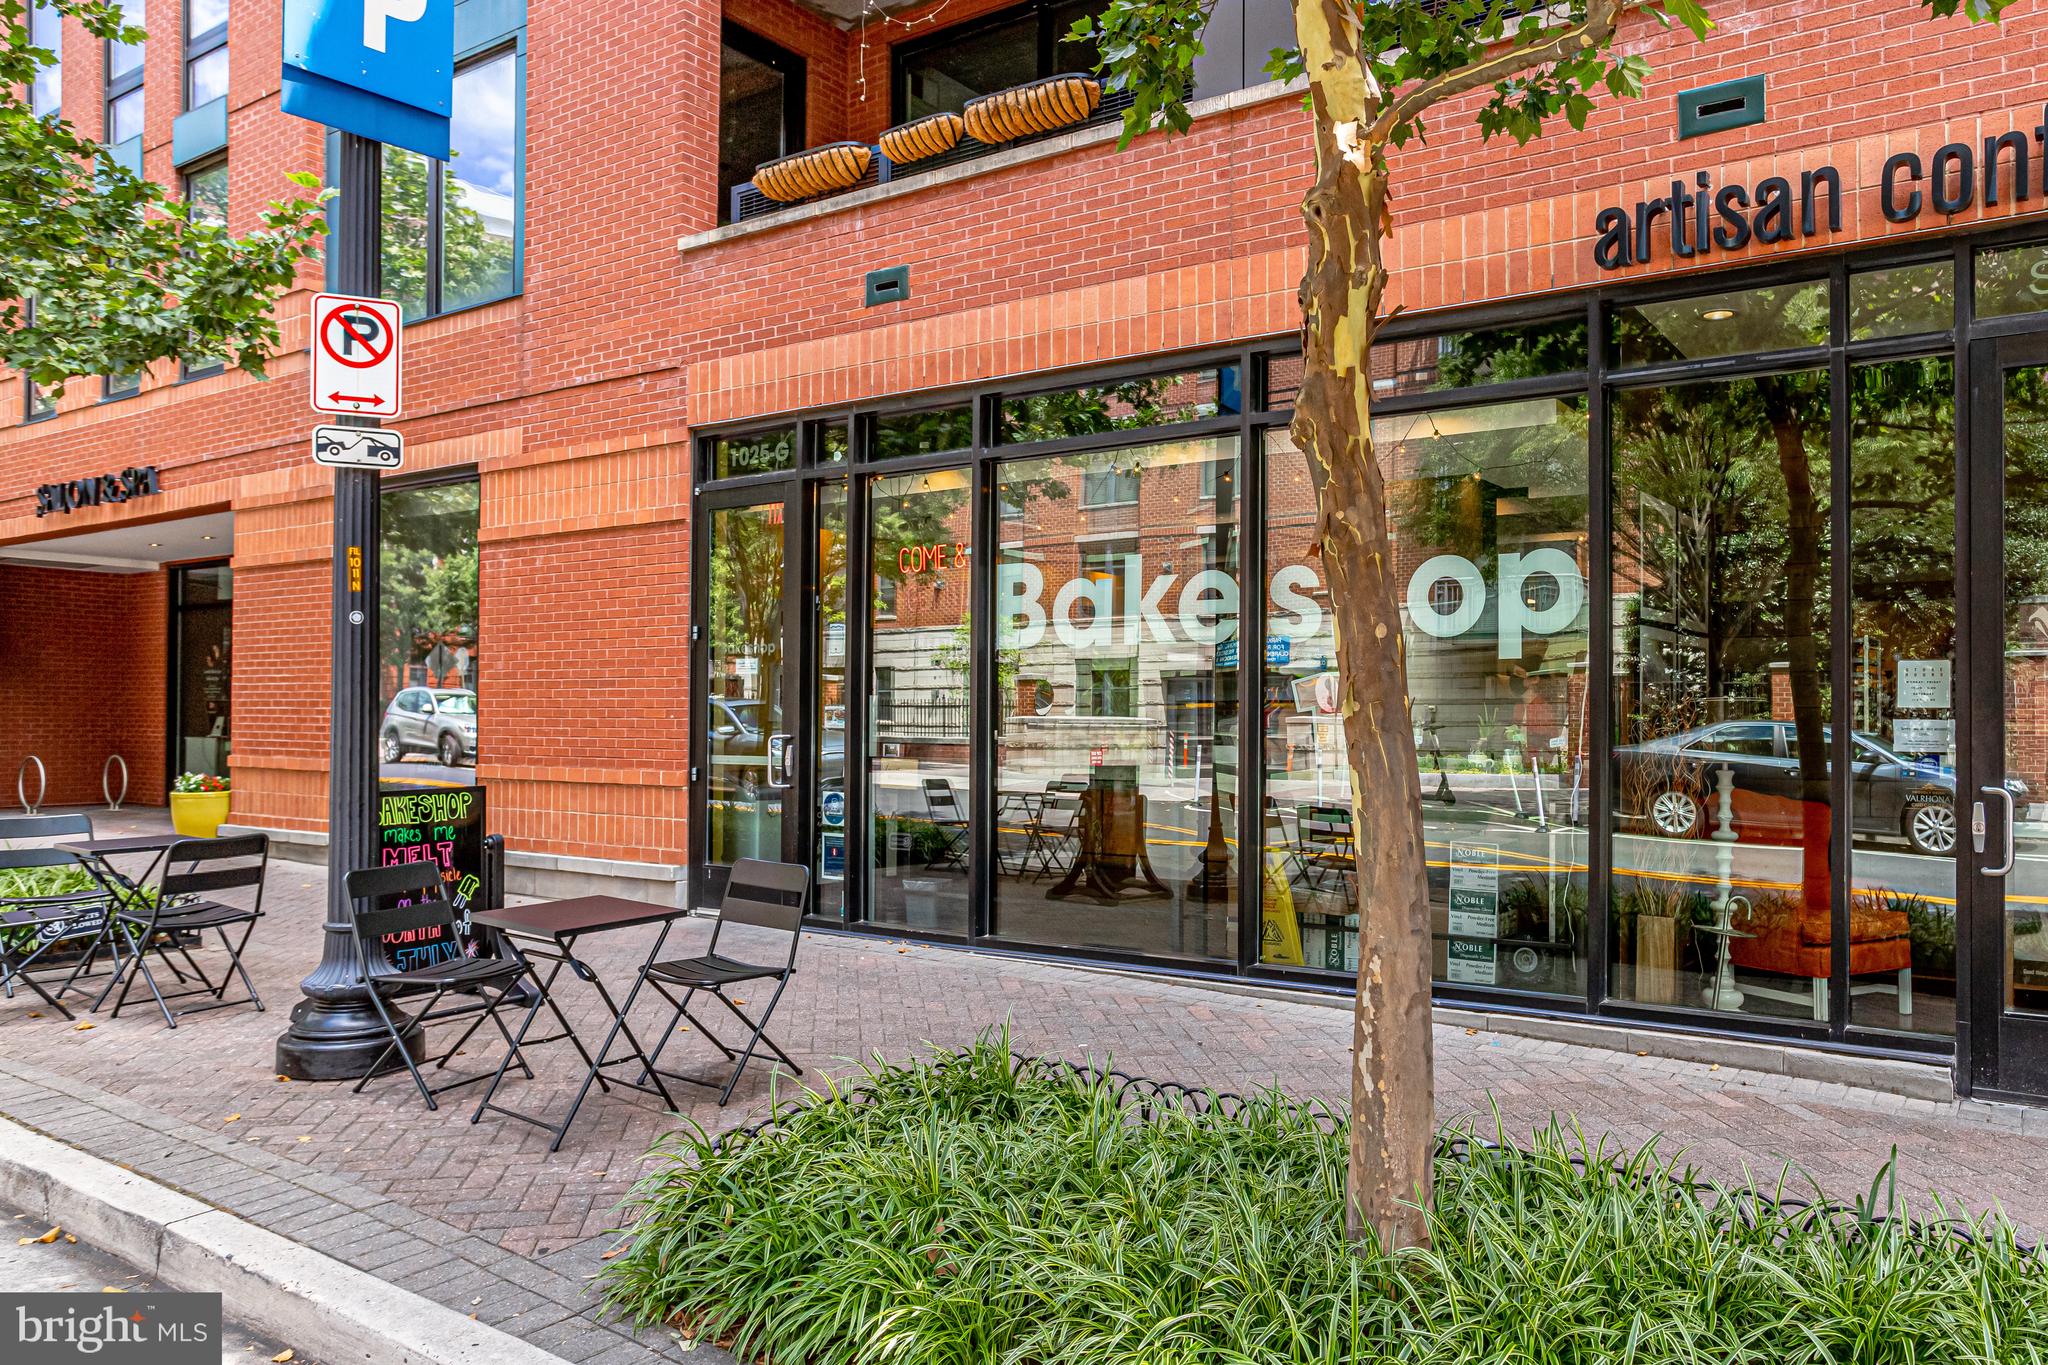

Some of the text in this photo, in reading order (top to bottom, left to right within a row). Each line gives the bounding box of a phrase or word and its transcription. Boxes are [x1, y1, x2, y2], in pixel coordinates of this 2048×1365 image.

[1594, 166, 1842, 270] artisan
[730, 442, 790, 467] 1025-G
[349, 558, 361, 567] 10
[899, 542, 966, 573] COME &
[352, 568, 360, 578] 11
[352, 581, 361, 591] N
[996, 548, 1583, 660] Bakesop
[1905, 794, 1951, 803] VALRHONA
[379, 792, 473, 826] AKESHOP
[384, 826, 456, 843] makes me
[382, 842, 455, 868] MELT
[440, 867, 463, 882] sicle
[1454, 894, 1484, 905] NOBLE
[1328, 933, 1339, 967] NOBLE
[1453, 942, 1482, 952] NOBLE
